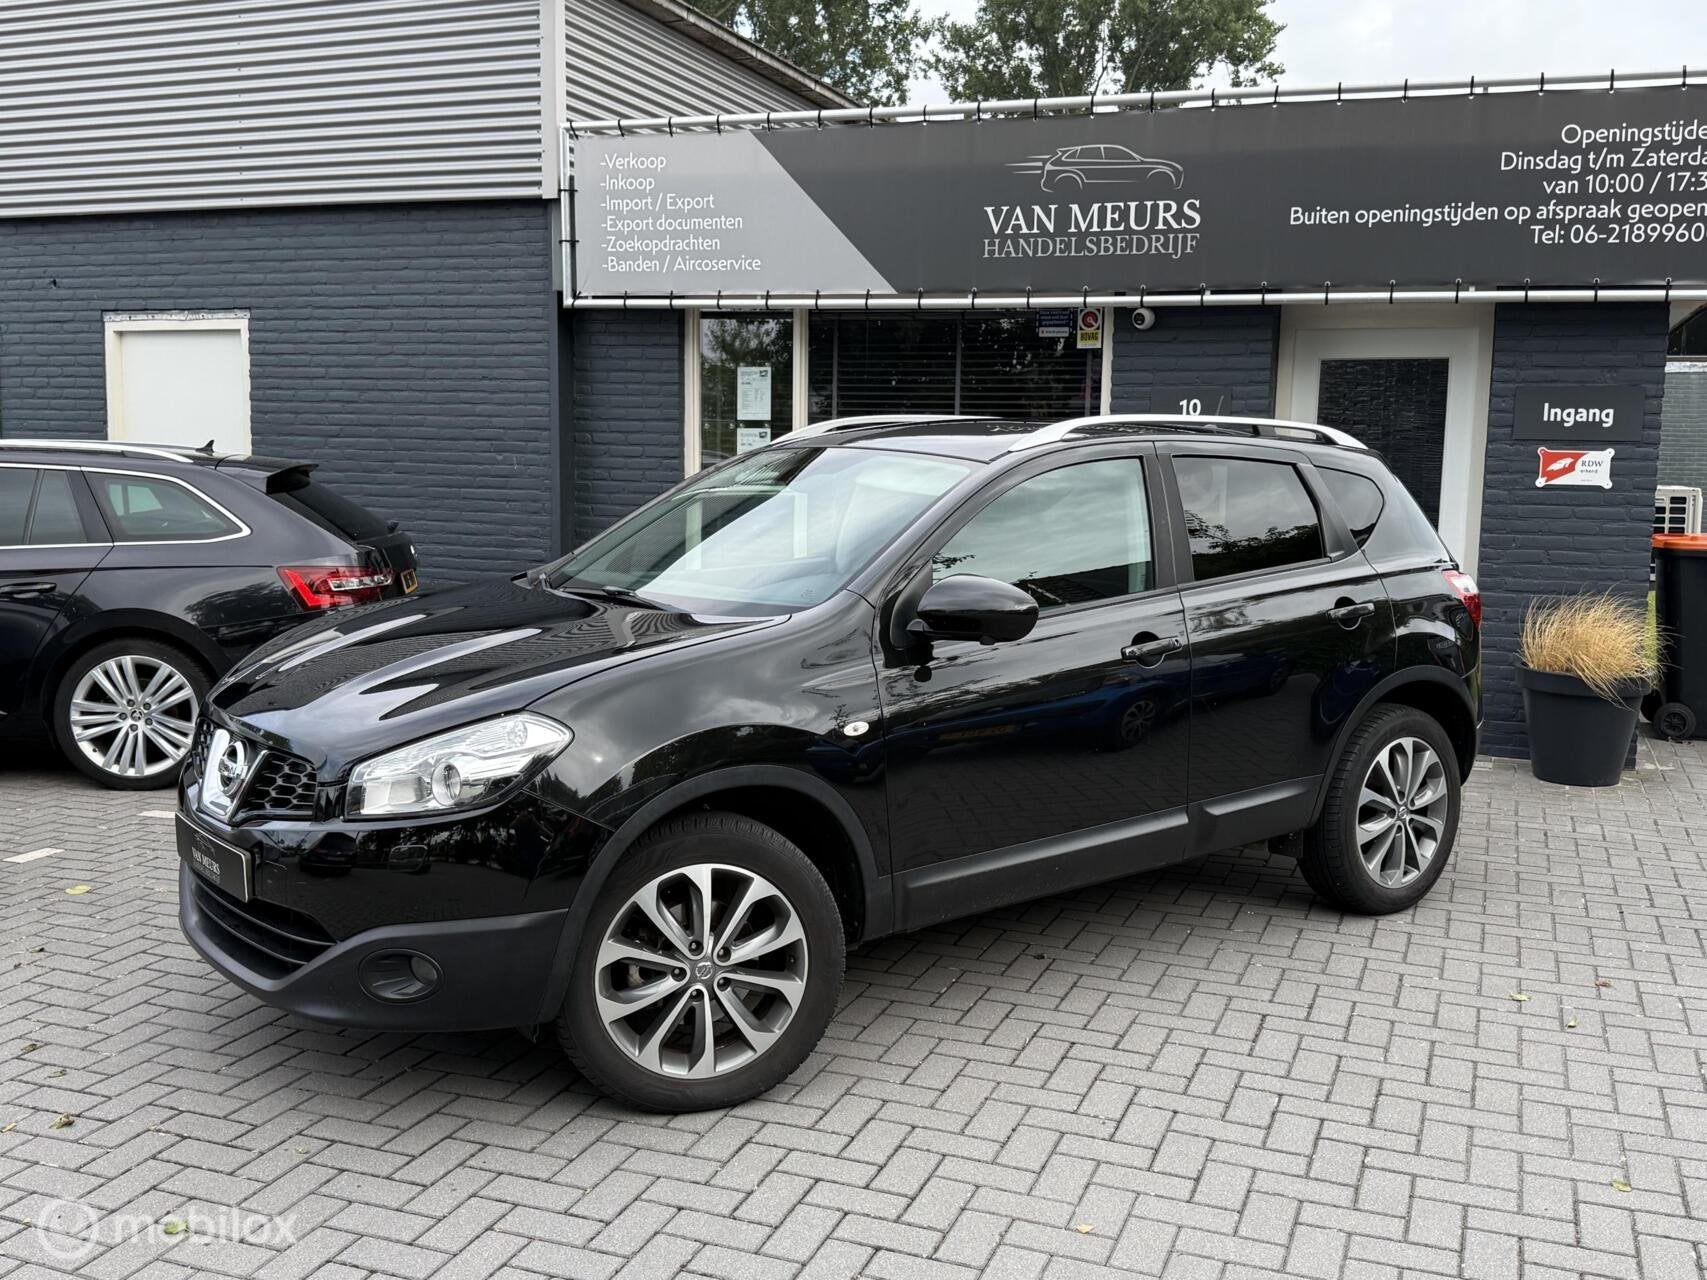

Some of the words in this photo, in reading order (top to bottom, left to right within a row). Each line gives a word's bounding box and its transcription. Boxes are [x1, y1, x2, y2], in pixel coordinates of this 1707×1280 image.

[600, 152, 666, 172] -Verkoop
[1501, 150, 1582, 174] Dinsdag
[1588, 148, 1624, 170] t/m
[600, 173, 654, 193] -Inkoop
[1543, 180, 1578, 194] van
[1586, 173, 1644, 193] 10:00
[1649, 172, 1661, 194] /
[600, 195, 653, 214] -Import
[656, 193, 662, 211] /
[667, 194, 714, 213] Export
[1290, 206, 1349, 224] Buiten
[1355, 202, 1498, 227] openingstijden
[1504, 207, 1531, 224] op
[1536, 199, 1622, 223] afspraak
[601, 216, 653, 235] -Export
[657, 214, 742, 230] documenten
[984, 205, 1058, 234] VAN
[1068, 199, 1200, 232] MEURS
[1530, 224, 1564, 244] Tel:
[1571, 223, 1707, 243] 06-2189960
[983, 233, 1199, 259] HANDELSBEDRIJF
[602, 256, 659, 271] -Banden
[663, 255, 670, 272] /
[674, 256, 761, 271] Aircoservice
[1080, 332, 1099, 342] BOVAG
[1179, 398, 1201, 415] 10
[1543, 402, 1615, 428] Ingang
